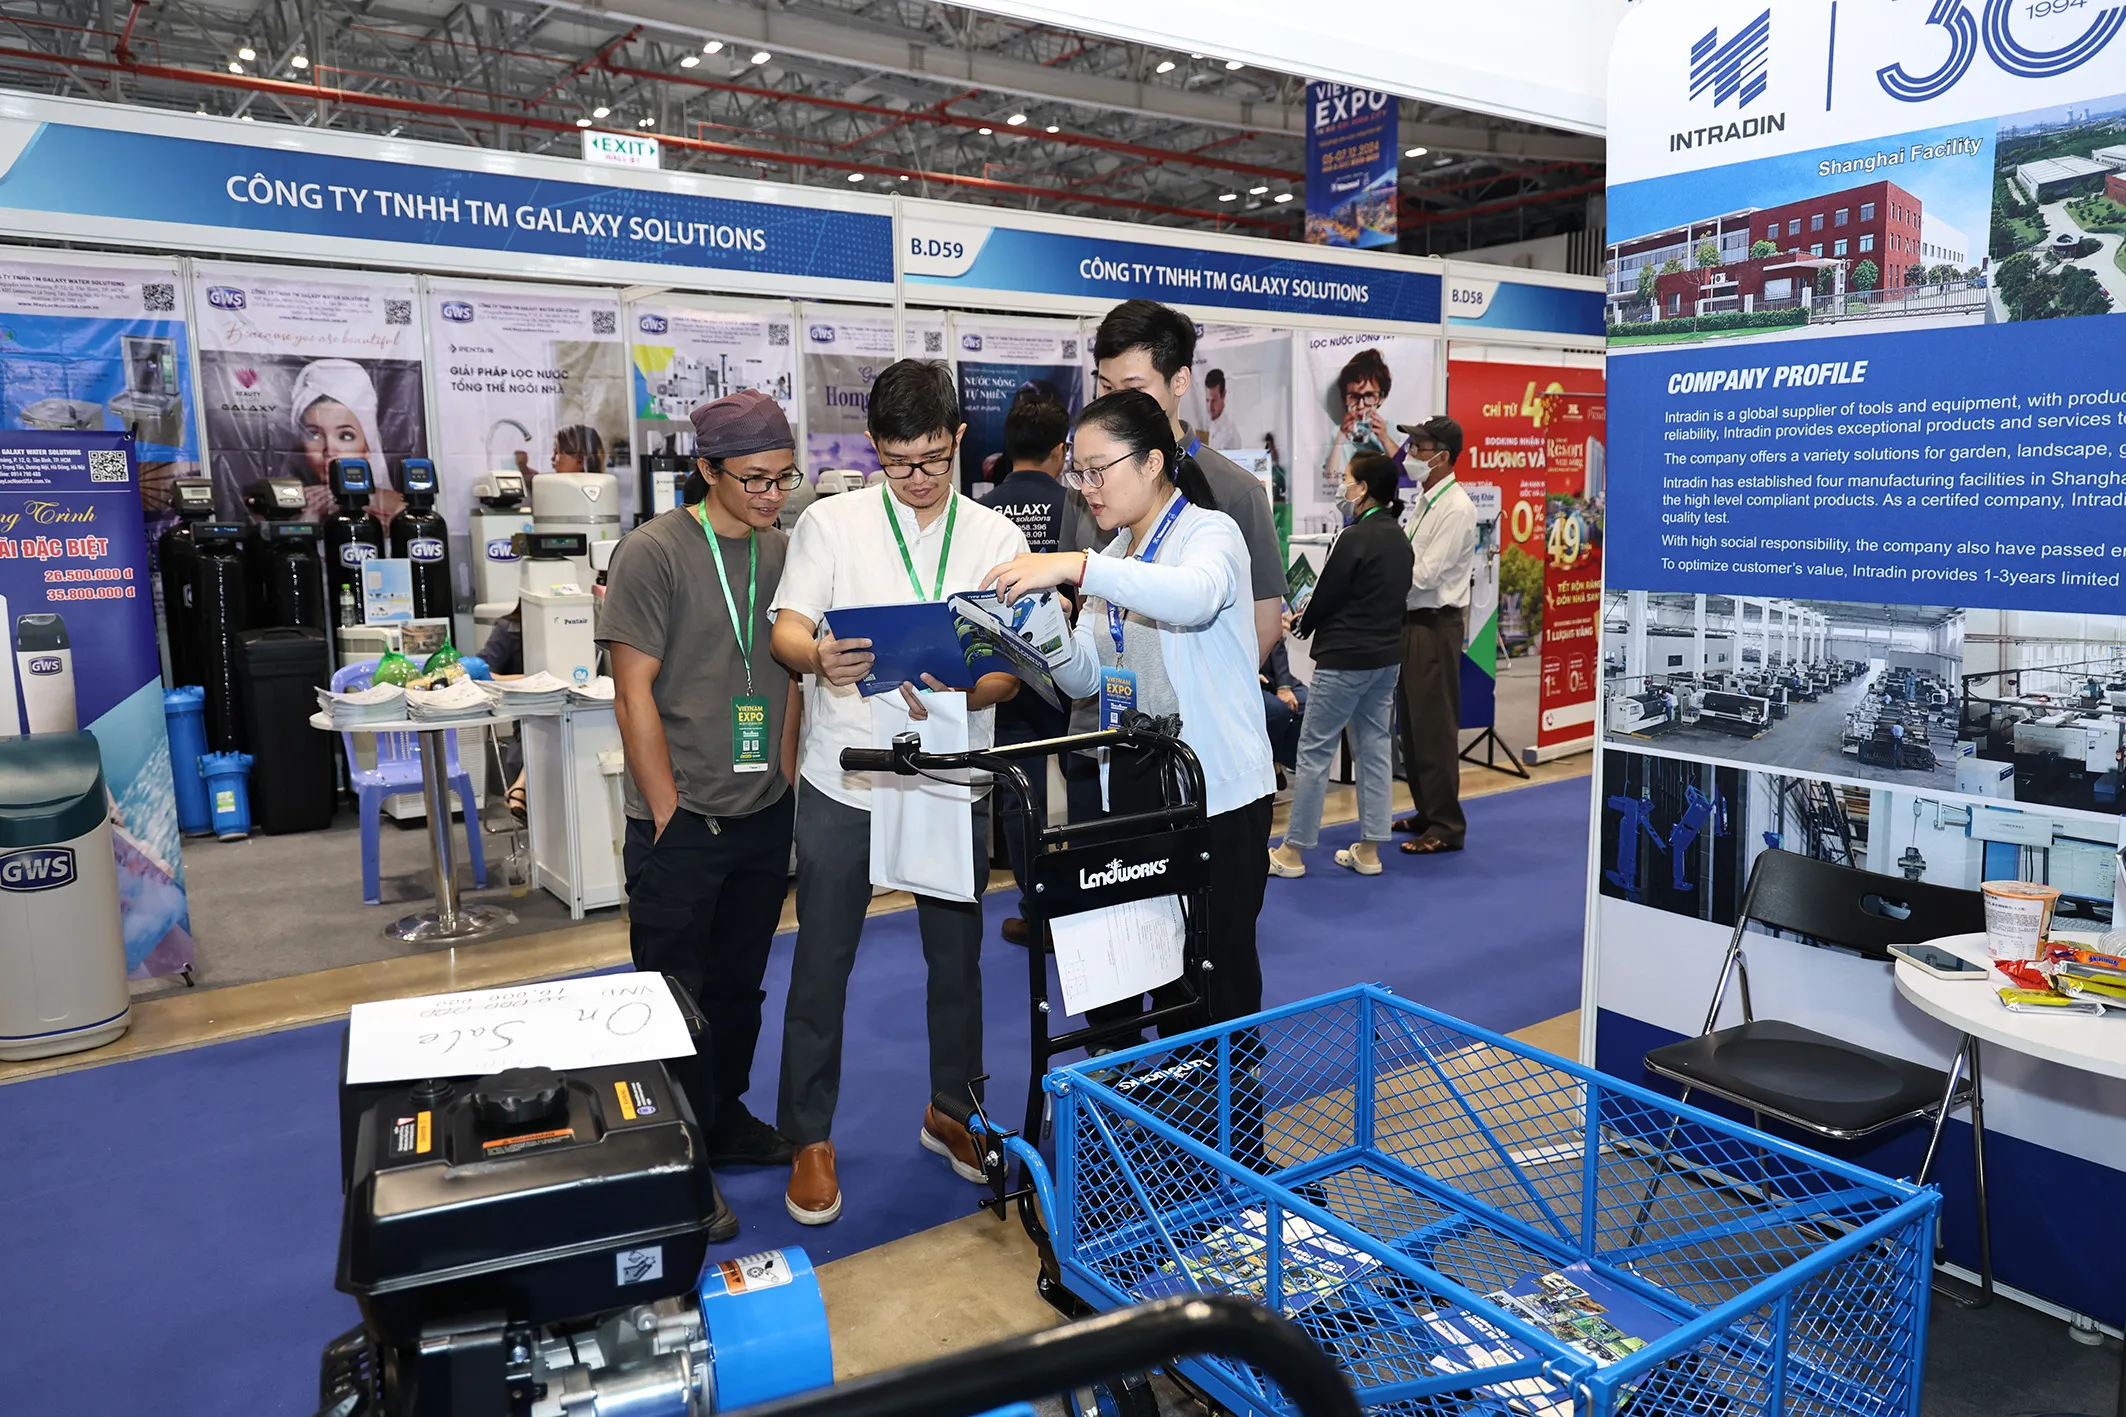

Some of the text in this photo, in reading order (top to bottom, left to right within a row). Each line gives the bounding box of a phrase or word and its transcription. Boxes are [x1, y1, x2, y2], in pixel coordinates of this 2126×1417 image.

[1315, 90, 1388, 127] EXPO
[1669, 112, 1786, 152] INTRADIN
[602, 137, 645, 155] EXIT
[1818, 136, 1983, 177] Shanghai Facility
[226, 172, 767, 252] CÔNG TY TNHH TM GALAXY SOLUTIONS
[911, 237, 964, 260] B.D59
[1080, 256, 1369, 304] CÔNG TY TNHH TM GALAXY SOLUTIONS
[210, 290, 242, 307] GWS
[1452, 289, 1483, 305] B.D58
[443, 305, 472, 320] GWS
[641, 317, 667, 331] GWS
[810, 327, 835, 341] GWS
[962, 337, 981, 349] GWS
[477, 366, 508, 378] PHÁP
[511, 369, 533, 381] LỌC
[1668, 360, 1869, 395] COMPANY PROFILE
[221, 403, 277, 412] GALAXY
[1665, 409, 1710, 424] Intradin
[1713, 408, 1724, 421] is
[1727, 410, 1736, 421] a
[1739, 406, 1778, 423] global
[1782, 403, 1837, 420] supplier
[1840, 401, 1856, 416] of
[1858, 400, 1894, 415] tools
[1898, 399, 1927, 414] and
[1931, 394, 2022, 414] equipment,
[2027, 392, 2063, 408] with
[1664, 411, 2111, 442] reliability, Intradin provides exceptional products and services
[1469, 446, 1478, 468] 1
[1480, 449, 1526, 472] LƯỢNG
[1664, 442, 2113, 467] The company offers a variety solutions for garden, landscape,
[1663, 476, 1708, 489] Intradin
[1711, 475, 1734, 488] has
[1737, 475, 1812, 488] established
[1816, 474, 1844, 488] four
[1848, 473, 1955, 490] manufacturing
[1959, 472, 2025, 487] facilities
[2031, 472, 2046, 486] in
[993, 503, 1052, 517] GALAXY
[1663, 494, 1681, 506] the
[1684, 494, 1710, 509] high
[1714, 493, 1743, 506] level
[1746, 493, 1810, 509] compliant
[1814, 493, 1878, 508] products.
[1883, 493, 1902, 507] As
[1907, 496, 1917, 507] a
[1921, 492, 1979, 507] certifed
[1984, 494, 2065, 510] company,
[23, 500, 97, 525] Trình
[1015, 514, 1052, 523] solutions
[1662, 511, 1730, 526] quality test.
[22, 534, 109, 562] ĐẶC BIỆT
[1548, 515, 1580, 567] 49
[1662, 534, 2105, 558] With high social responsibility, the company also have passed
[342, 547, 377, 562] GWS
[411, 543, 443, 558] GWS
[44, 567, 120, 583] 26.500.000
[1662, 557, 2120, 587] To optimize customer's value, Intradin provides 1-3years limited
[46, 587, 123, 602] 35.800.000
[564, 616, 589, 626] Pentair
[31, 658, 60, 673] GWS
[1106, 683, 1133, 696] EXPO
[738, 712, 764, 722] EXPO
[2, 855, 69, 883] GWS
[417, 1001, 652, 1054] On Sale
